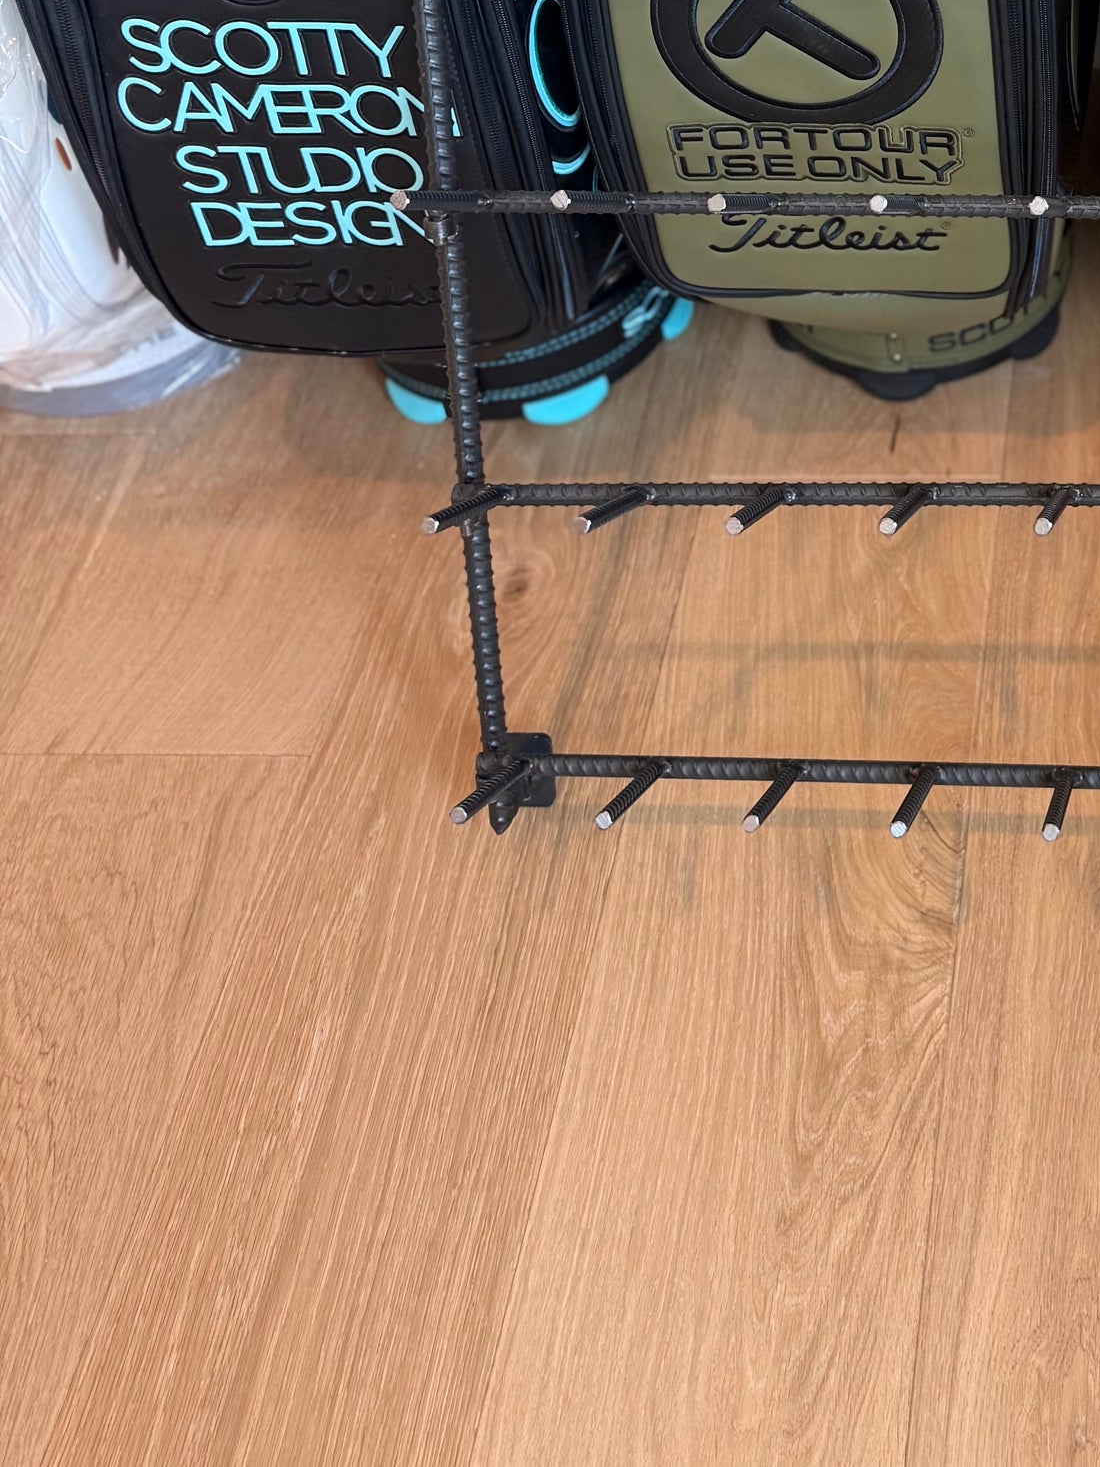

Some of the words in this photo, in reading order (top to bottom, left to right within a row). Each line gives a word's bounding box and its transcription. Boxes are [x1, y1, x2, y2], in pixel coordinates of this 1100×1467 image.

[120, 17, 405, 78] SCOTTY
[175, 144, 425, 194] STUDIO
[679, 154, 797, 178] USE
[806, 155, 958, 183] ONLY
[708, 212, 948, 253] Titleist
[211, 258, 443, 308] Titleis
